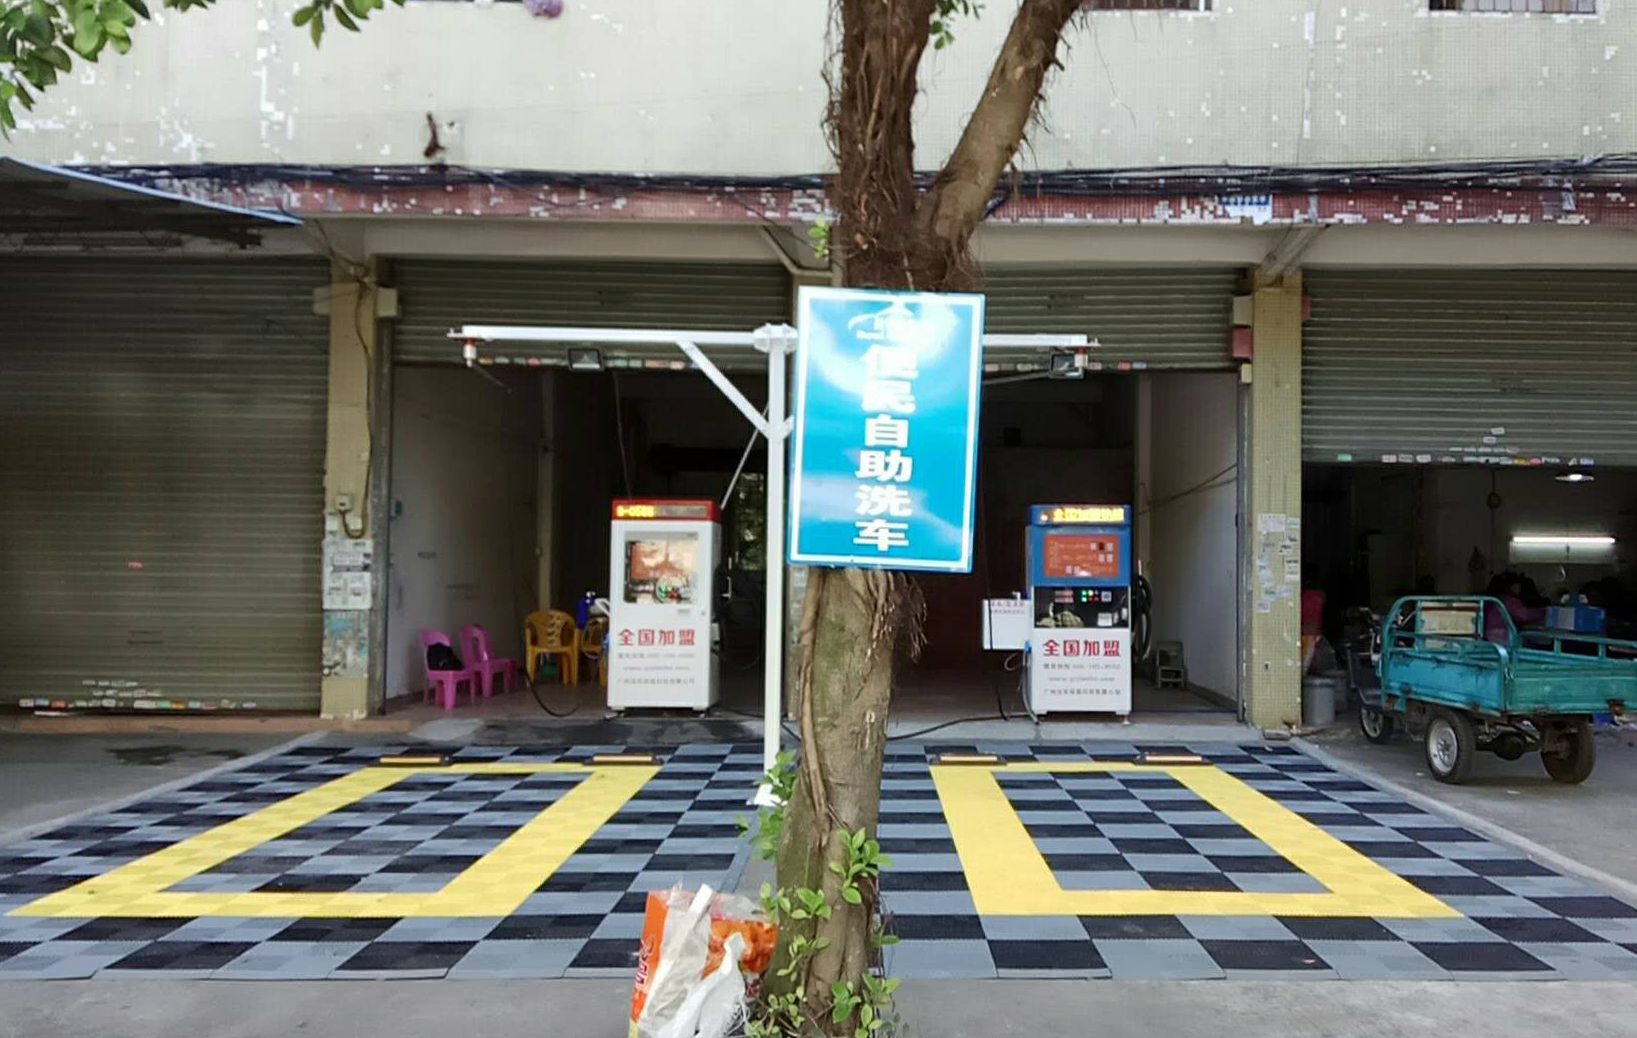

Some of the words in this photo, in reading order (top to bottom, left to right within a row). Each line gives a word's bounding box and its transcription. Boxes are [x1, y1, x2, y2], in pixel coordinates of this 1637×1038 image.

[617, 628, 696, 646] 全国加盟
[1043, 639, 1120, 657] 全国加盟
